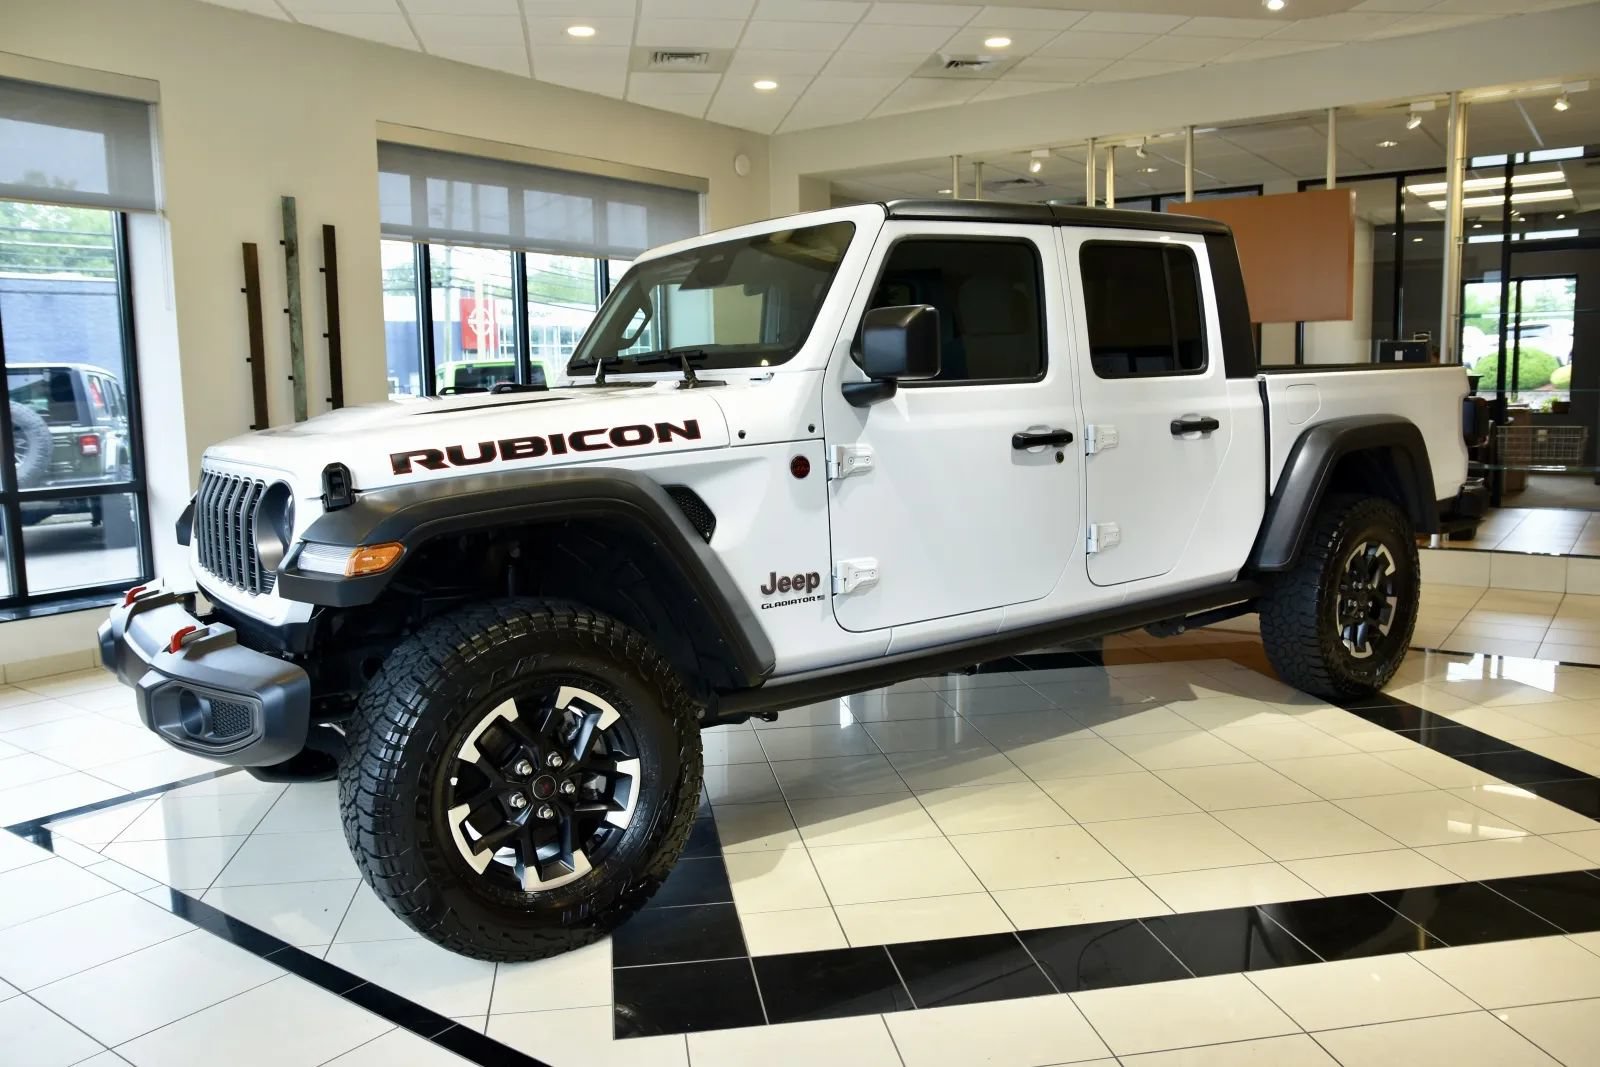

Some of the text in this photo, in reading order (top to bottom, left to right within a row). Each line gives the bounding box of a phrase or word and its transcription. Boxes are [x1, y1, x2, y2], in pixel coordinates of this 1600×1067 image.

[389, 419, 701, 475] RUBICON
[760, 571, 820, 595] Jeep
[761, 595, 816, 610] GLADIATOR
